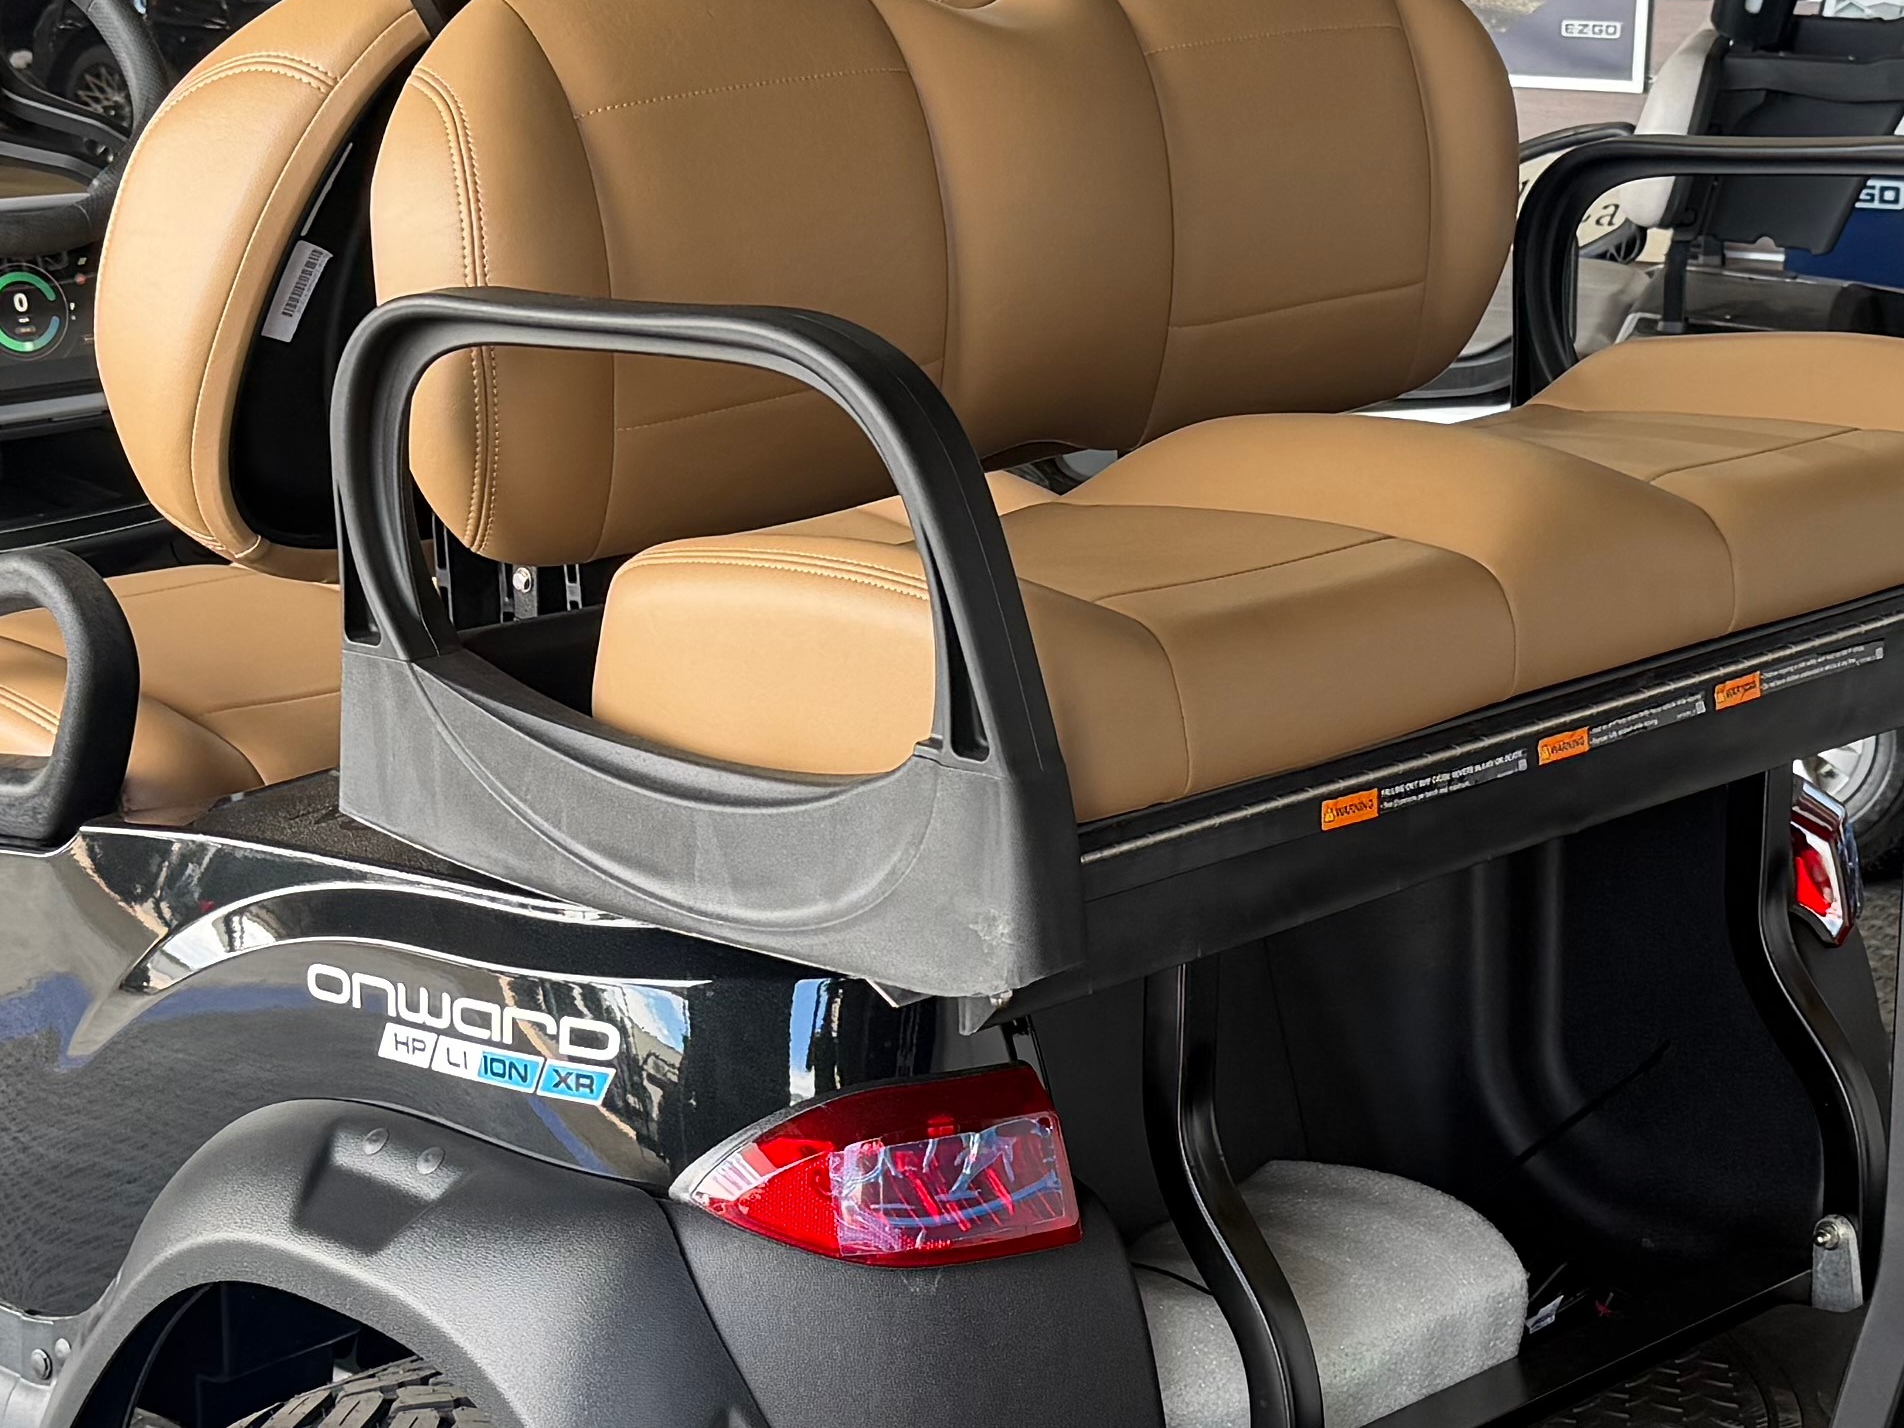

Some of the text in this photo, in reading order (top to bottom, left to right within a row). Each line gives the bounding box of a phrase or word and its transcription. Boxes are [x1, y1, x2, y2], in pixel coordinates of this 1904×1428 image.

[13, 292, 28, 312] 0
[393, 1032, 596, 1095] HP LI ION XR
